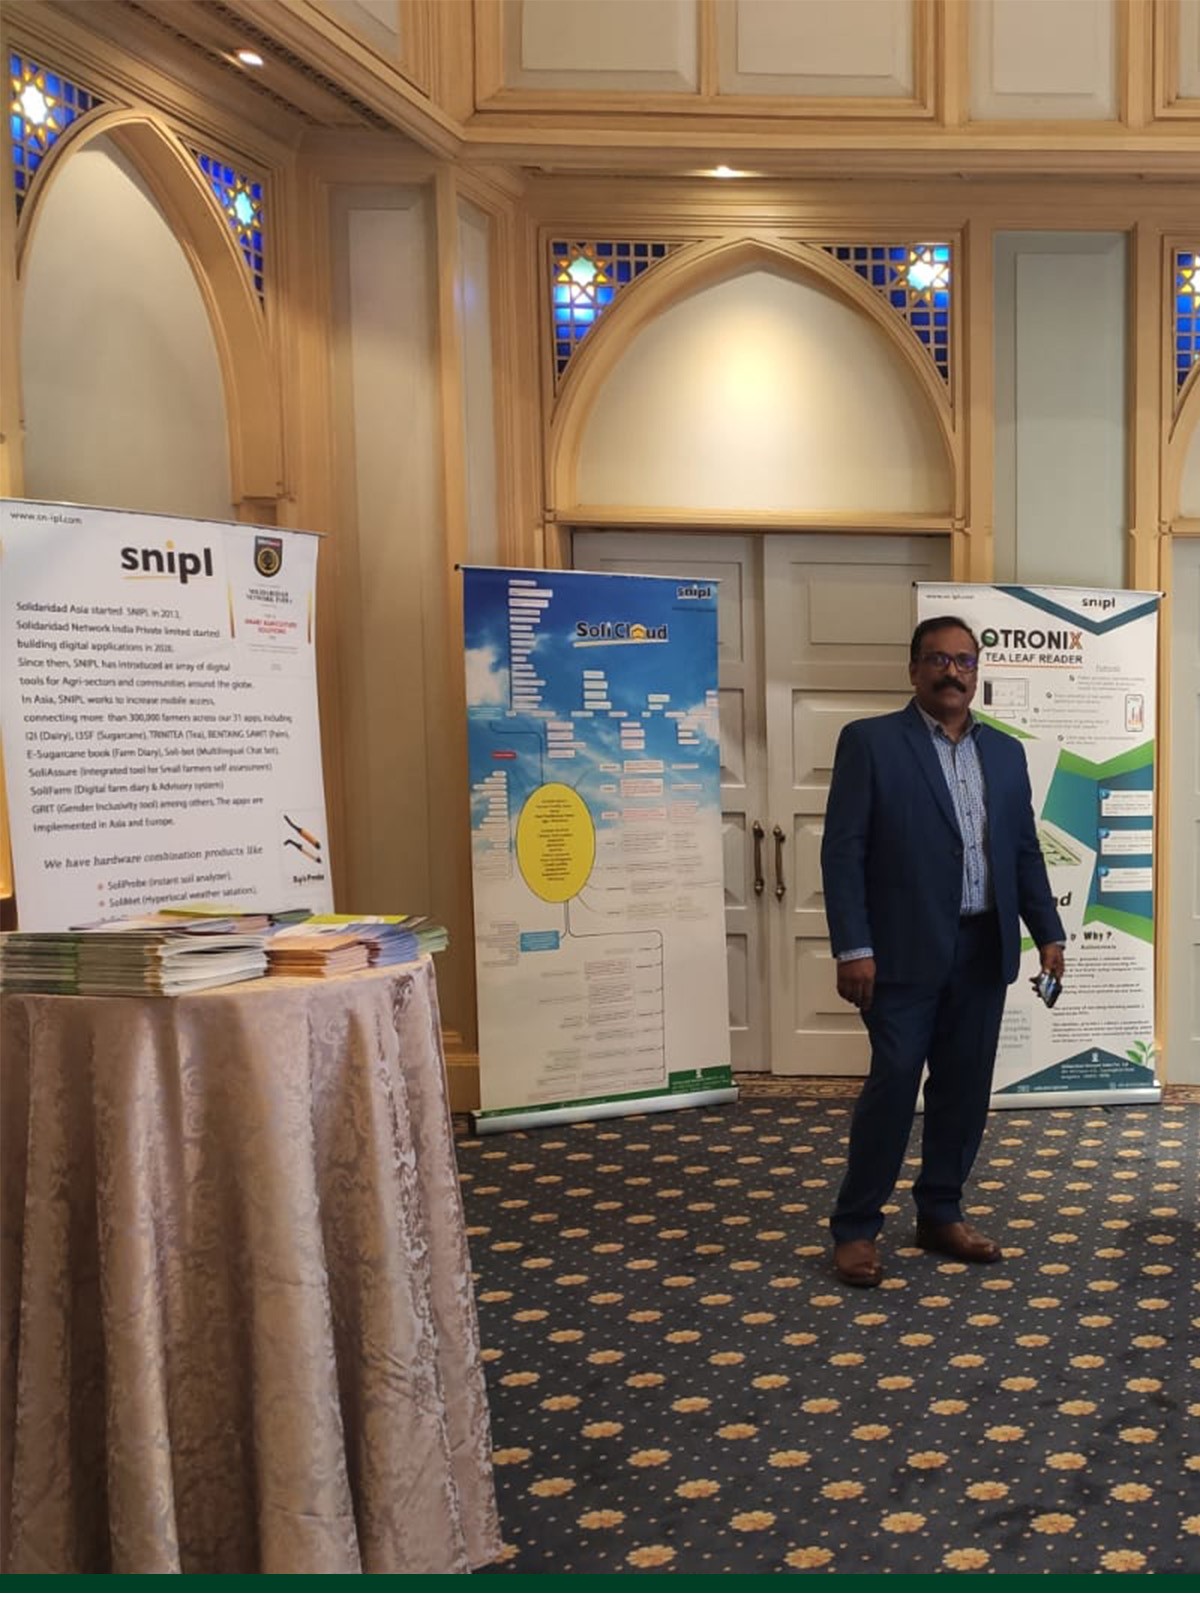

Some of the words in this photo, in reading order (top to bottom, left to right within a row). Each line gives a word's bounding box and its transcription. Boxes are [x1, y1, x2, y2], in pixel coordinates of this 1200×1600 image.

[121, 540, 213, 584] snipl
[678, 584, 711, 599] snipl
[16, 601, 68, 613] Solidaridad
[70, 604, 88, 614] Asia
[91, 606, 122, 616] started
[1082, 597, 1115, 610] snipl
[16, 620, 70, 632] Solidaridad
[72, 622, 110, 633] Network
[112, 623, 134, 634] India
[136, 625, 162, 636] Private
[193, 628, 220, 638] started
[17, 638, 57, 651] building
[59, 640, 88, 651] digital
[91, 641, 142, 653] applications
[18, 656, 44, 667] Since
[102, 659, 116, 669] has
[118, 660, 162, 670] introduced
[176, 662, 194, 673] array
[206, 662, 230, 674] digital
[986, 652, 1006, 663] TEA
[1009, 653, 1036, 664] LEAF
[1039, 653, 1083, 664] READER
[20, 675, 44, 686] tools
[46, 675, 60, 686] for
[118, 677, 134, 687] and
[136, 678, 186, 689] communities
[188, 679, 216, 689] around
[218, 679, 230, 689] the
[24, 712, 78, 724] connecting
[80, 713, 104, 722] more
[107, 712, 128, 722] than
[162, 712, 191, 723] farmers
[88, 748, 110, 759] book
[129, 764, 146, 775] tool
[182, 763, 212, 774] farmers
[108, 783, 128, 793] farm
[130, 782, 150, 794] diary
[152, 782, 158, 792] &
[160, 781, 192, 793] Advisory
[108, 818, 126, 829] Asia
[128, 818, 144, 828] and
[44, 858, 62, 870] We
[66, 857, 91, 869] have
[93, 853, 142, 867] hardware
[144, 849, 202, 863] combination
[204, 847, 244, 860] products
[246, 844, 264, 855] like
